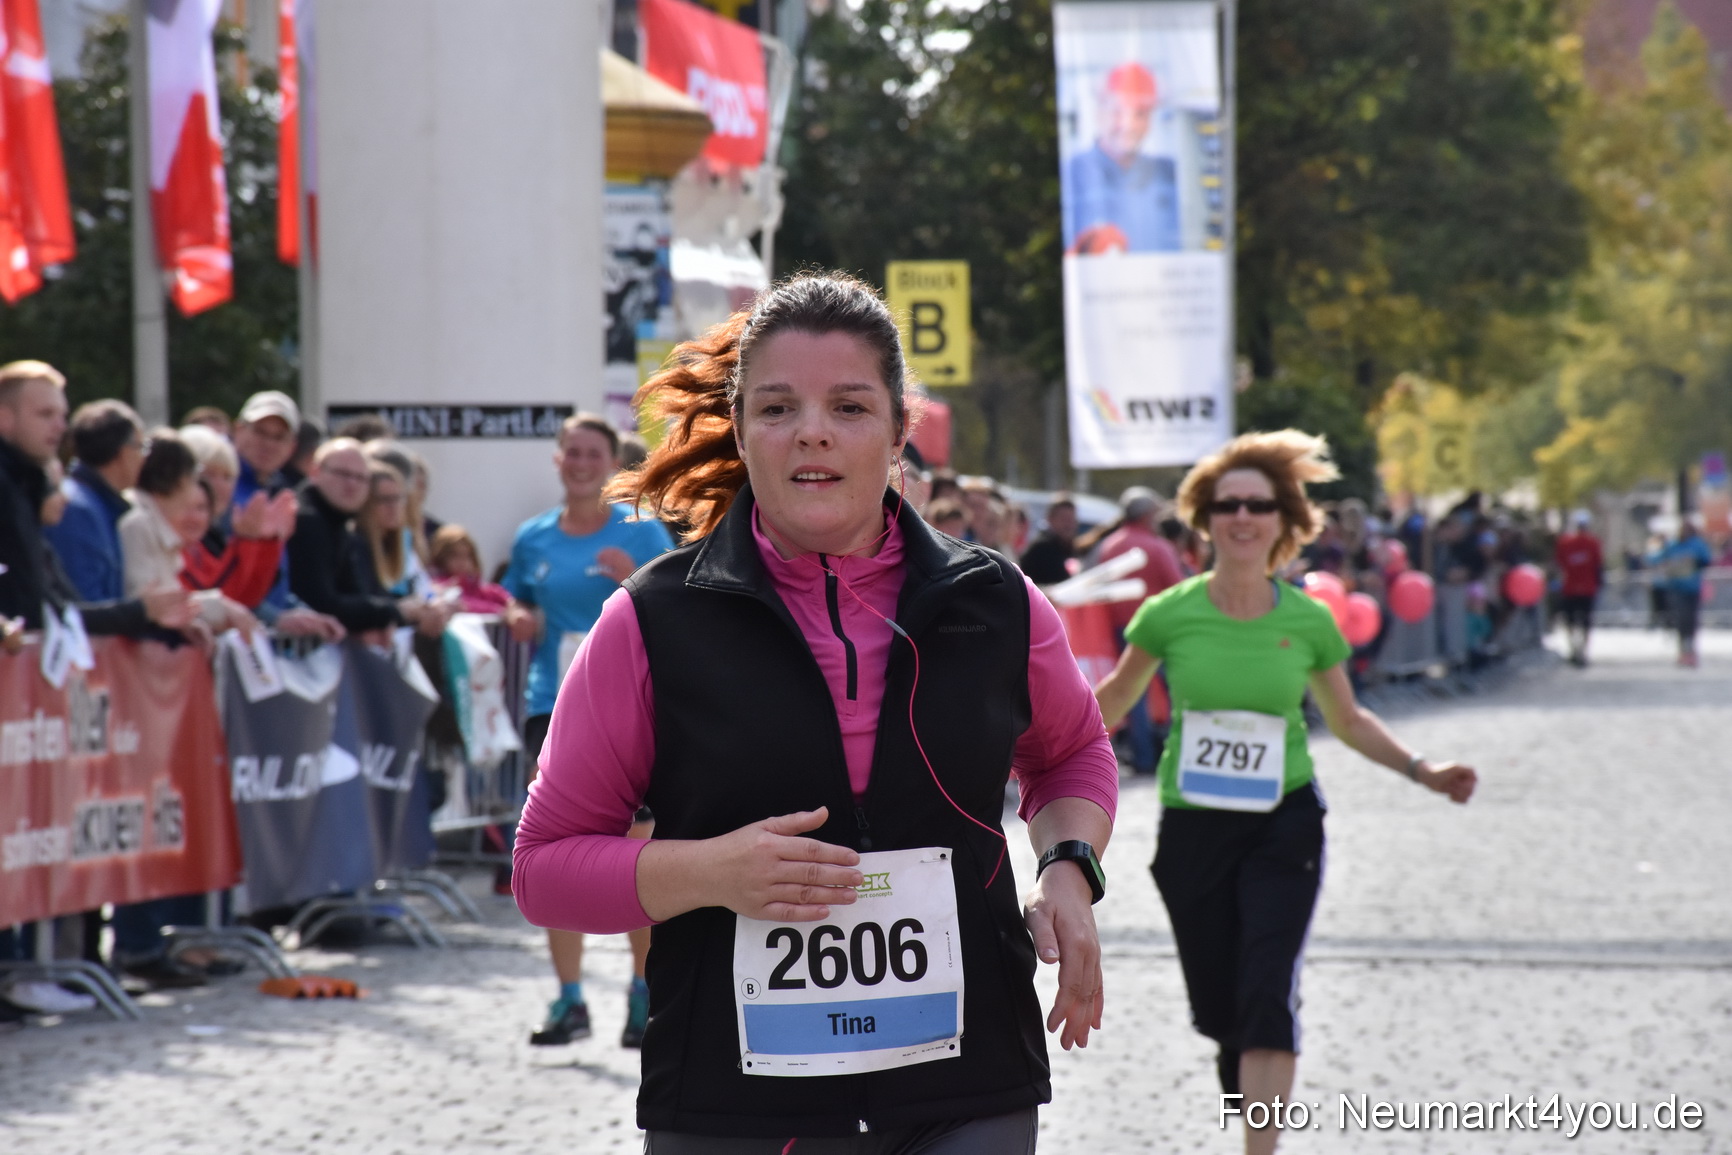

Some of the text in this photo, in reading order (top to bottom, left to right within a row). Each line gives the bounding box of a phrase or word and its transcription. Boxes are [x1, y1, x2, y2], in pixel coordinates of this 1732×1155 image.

[911, 302, 947, 355] B
[1434, 437, 1460, 472] C
[1197, 737, 1267, 771] 2797
[766, 918, 928, 991] 2606
[746, 983, 755, 995] B
[827, 1012, 876, 1036] Tina
